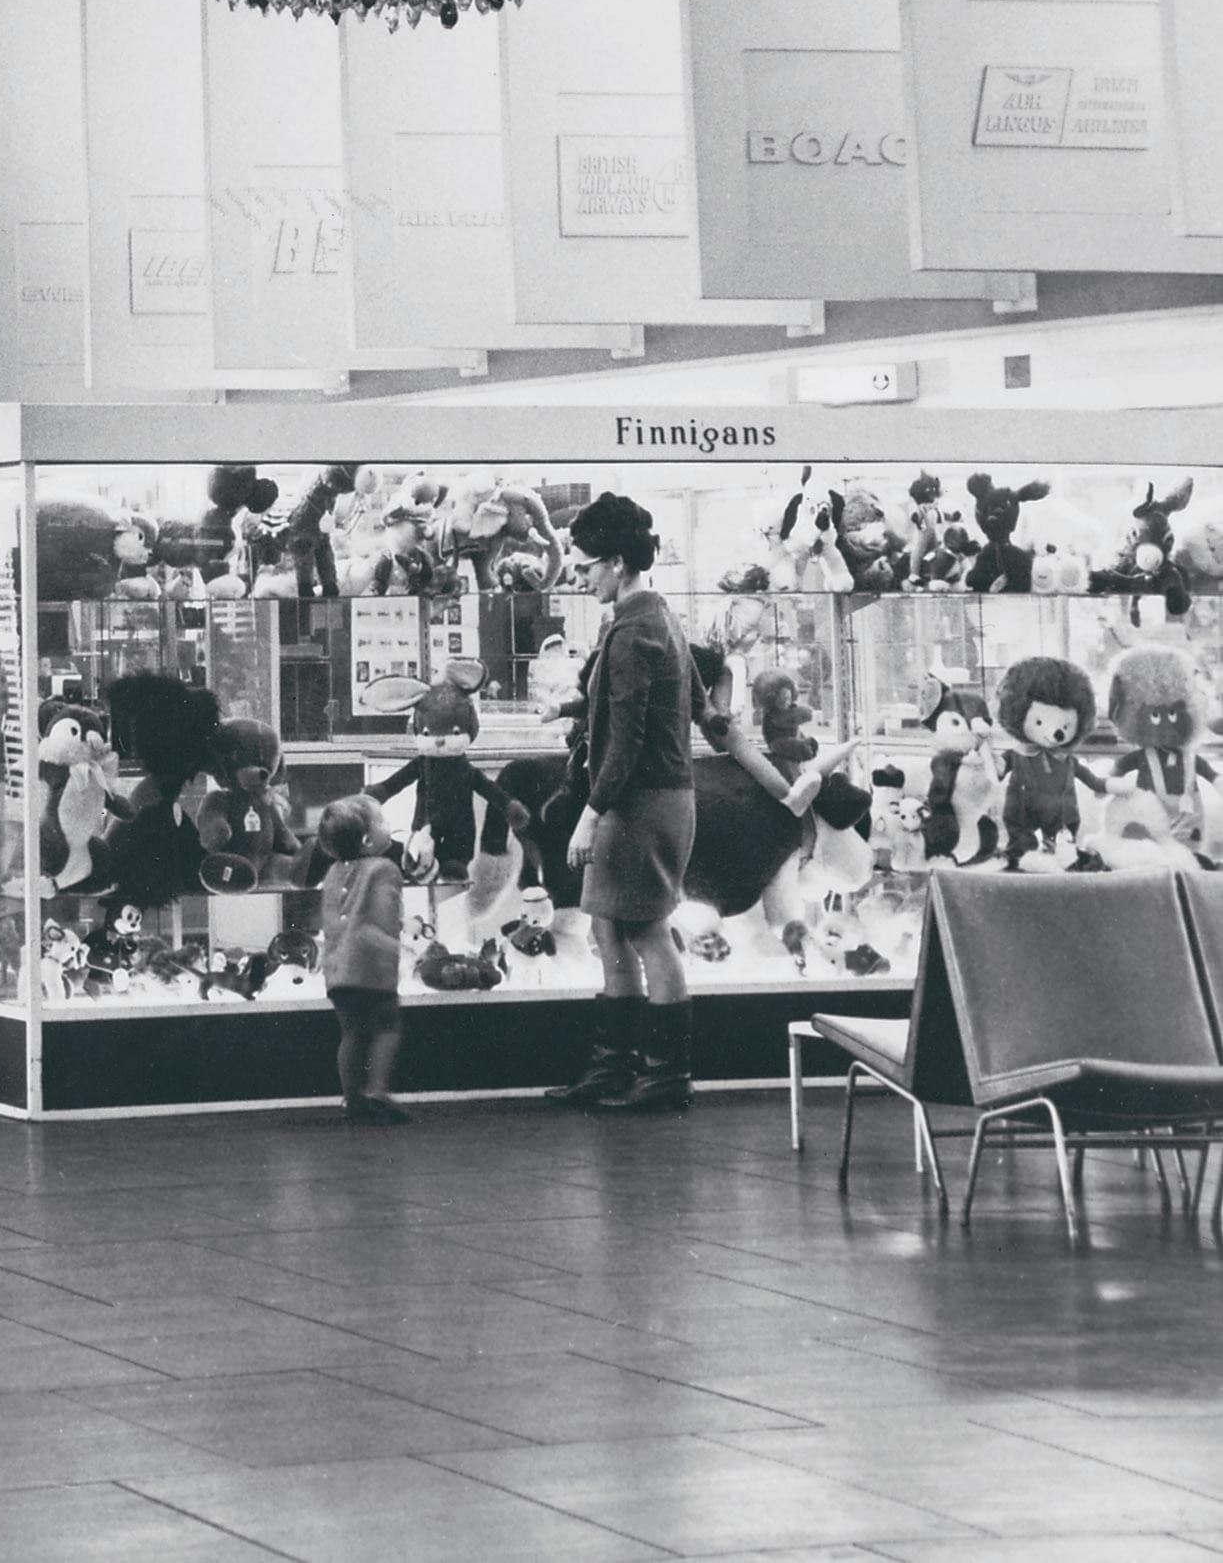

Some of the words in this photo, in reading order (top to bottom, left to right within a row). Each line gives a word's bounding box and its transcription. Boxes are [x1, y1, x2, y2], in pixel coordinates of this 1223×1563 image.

[745, 130, 907, 167] BOAC
[576, 155, 638, 175] BRITISH
[576, 175, 650, 195] MIDLAND
[576, 196, 649, 215] AIRWAYS
[615, 415, 777, 454] Finnigans
